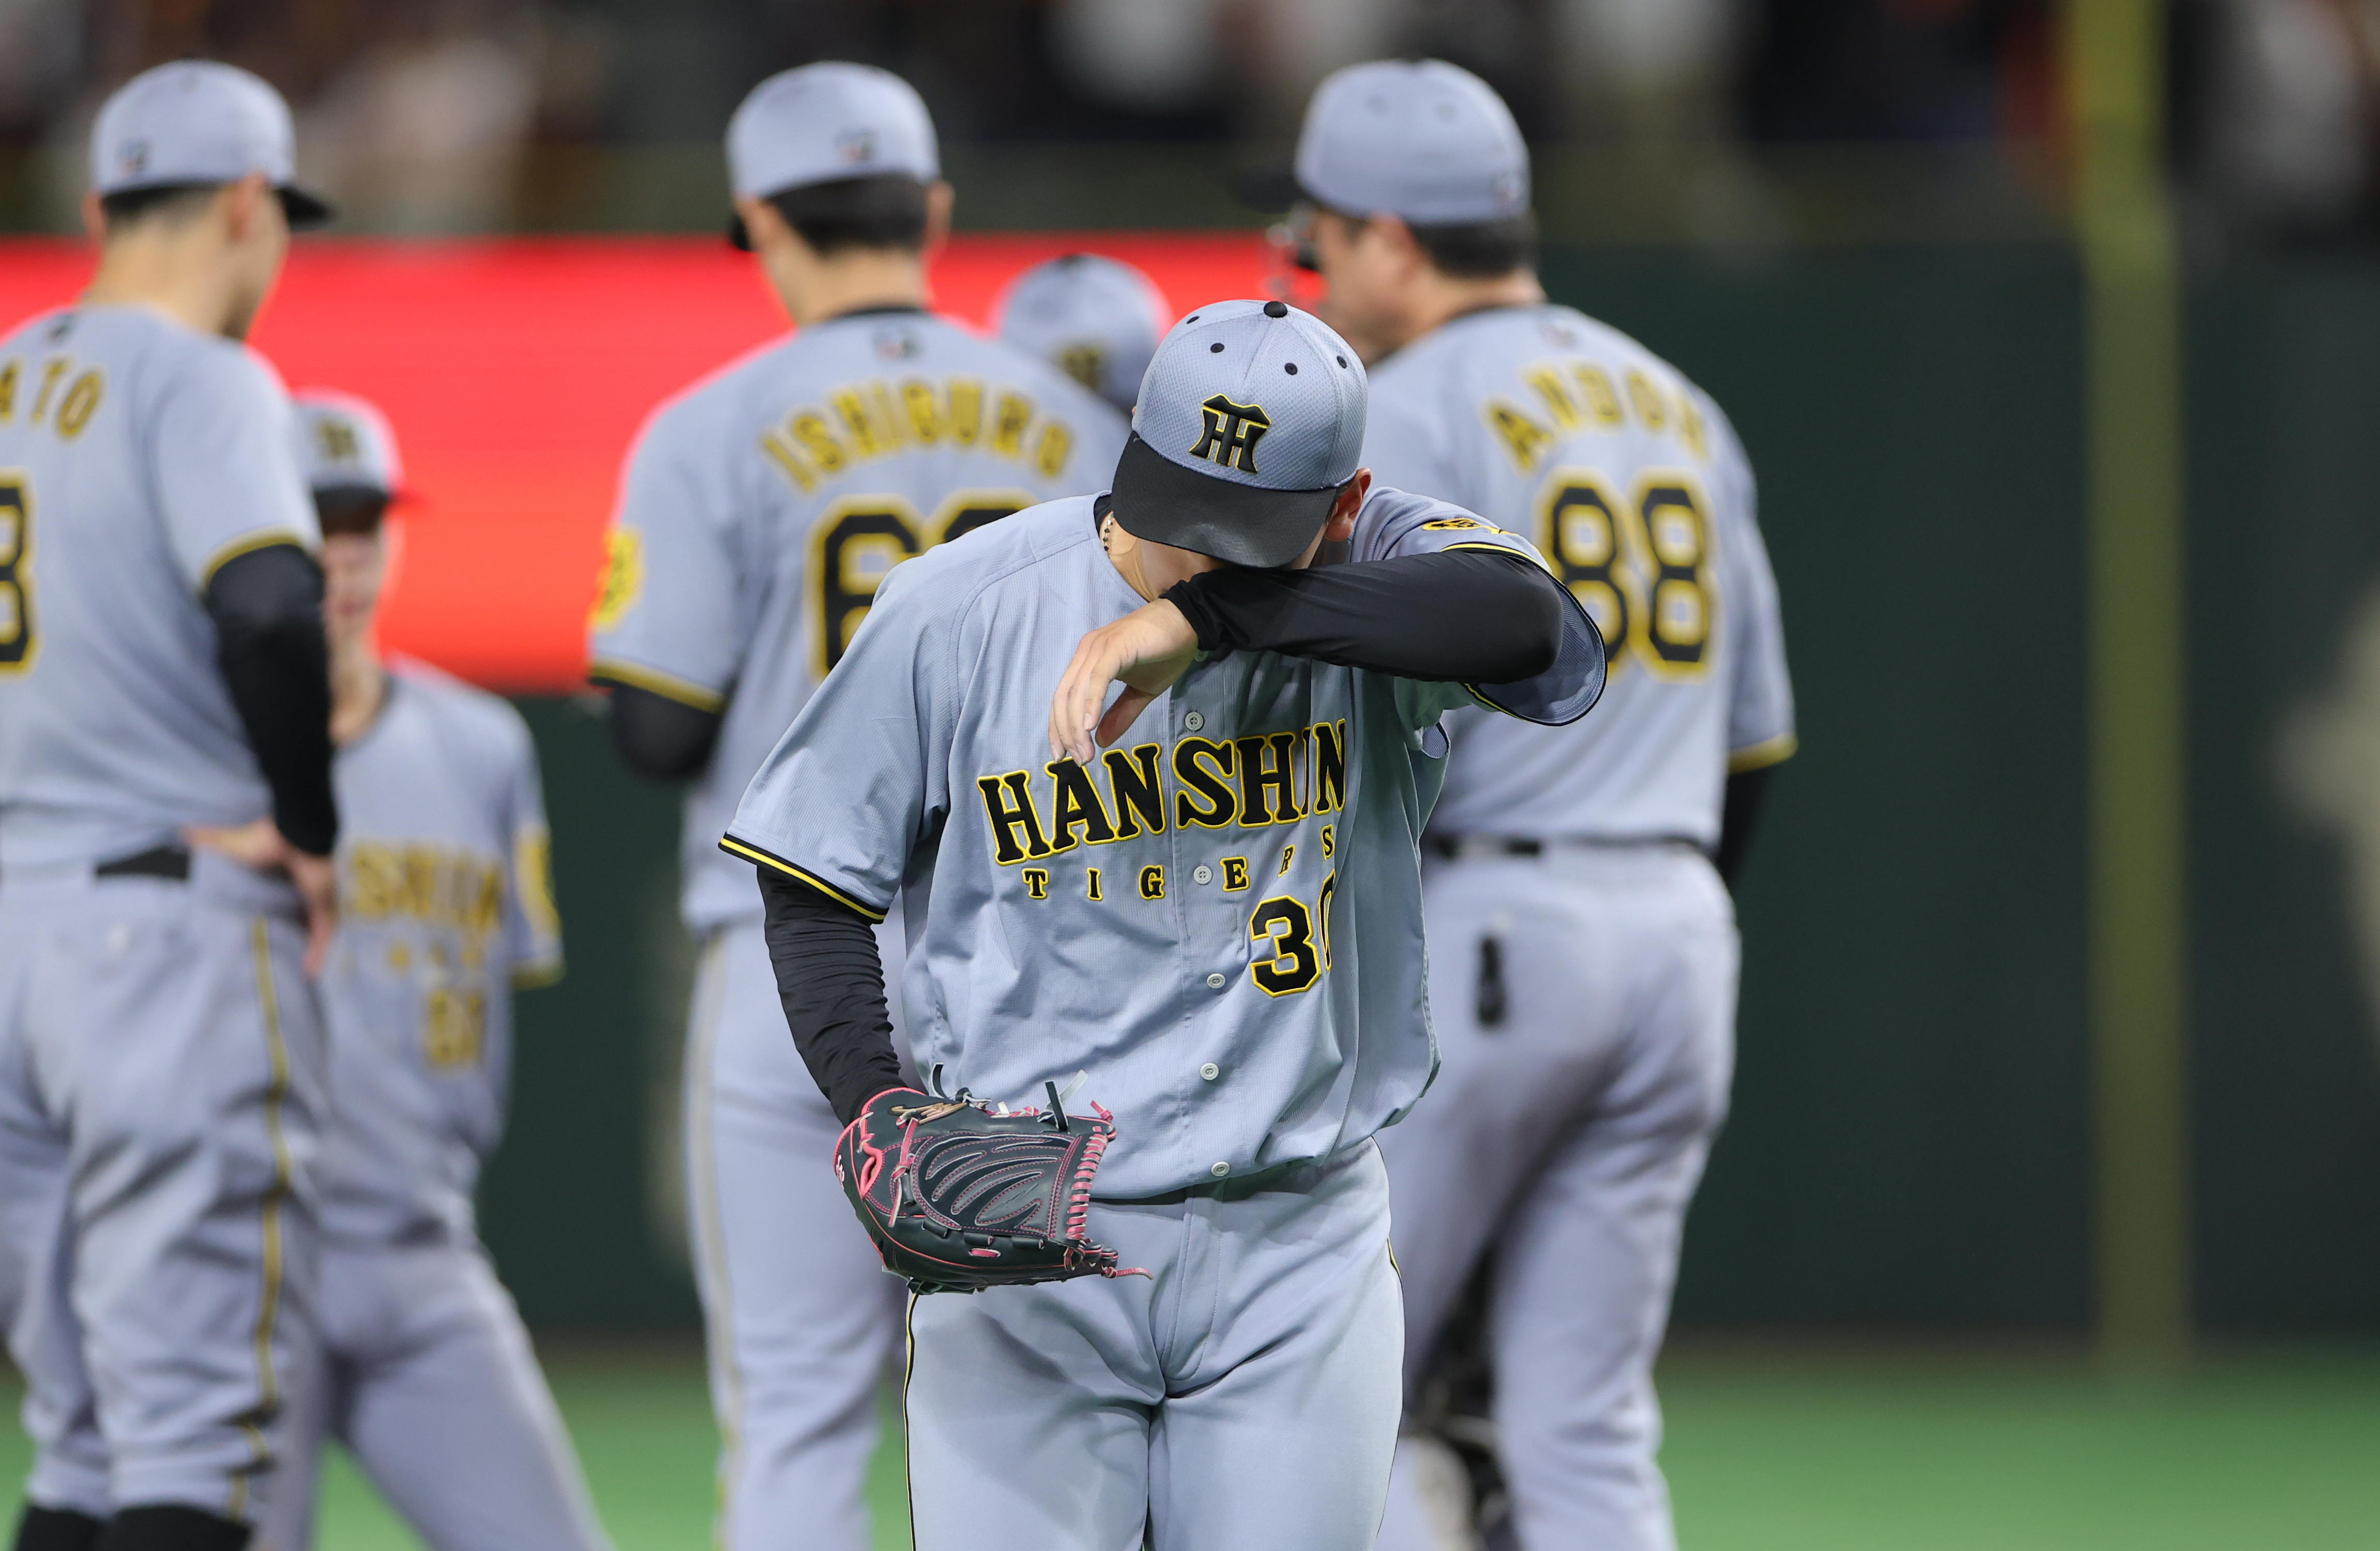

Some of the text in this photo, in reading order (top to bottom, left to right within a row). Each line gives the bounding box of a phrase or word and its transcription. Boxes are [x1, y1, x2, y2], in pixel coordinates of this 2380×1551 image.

[762, 375, 1070, 491] ISHIGURO
[805, 494, 1043, 686] 6
[1540, 469, 1715, 681] 88
[1022, 824, 1334, 901] TIGERS
